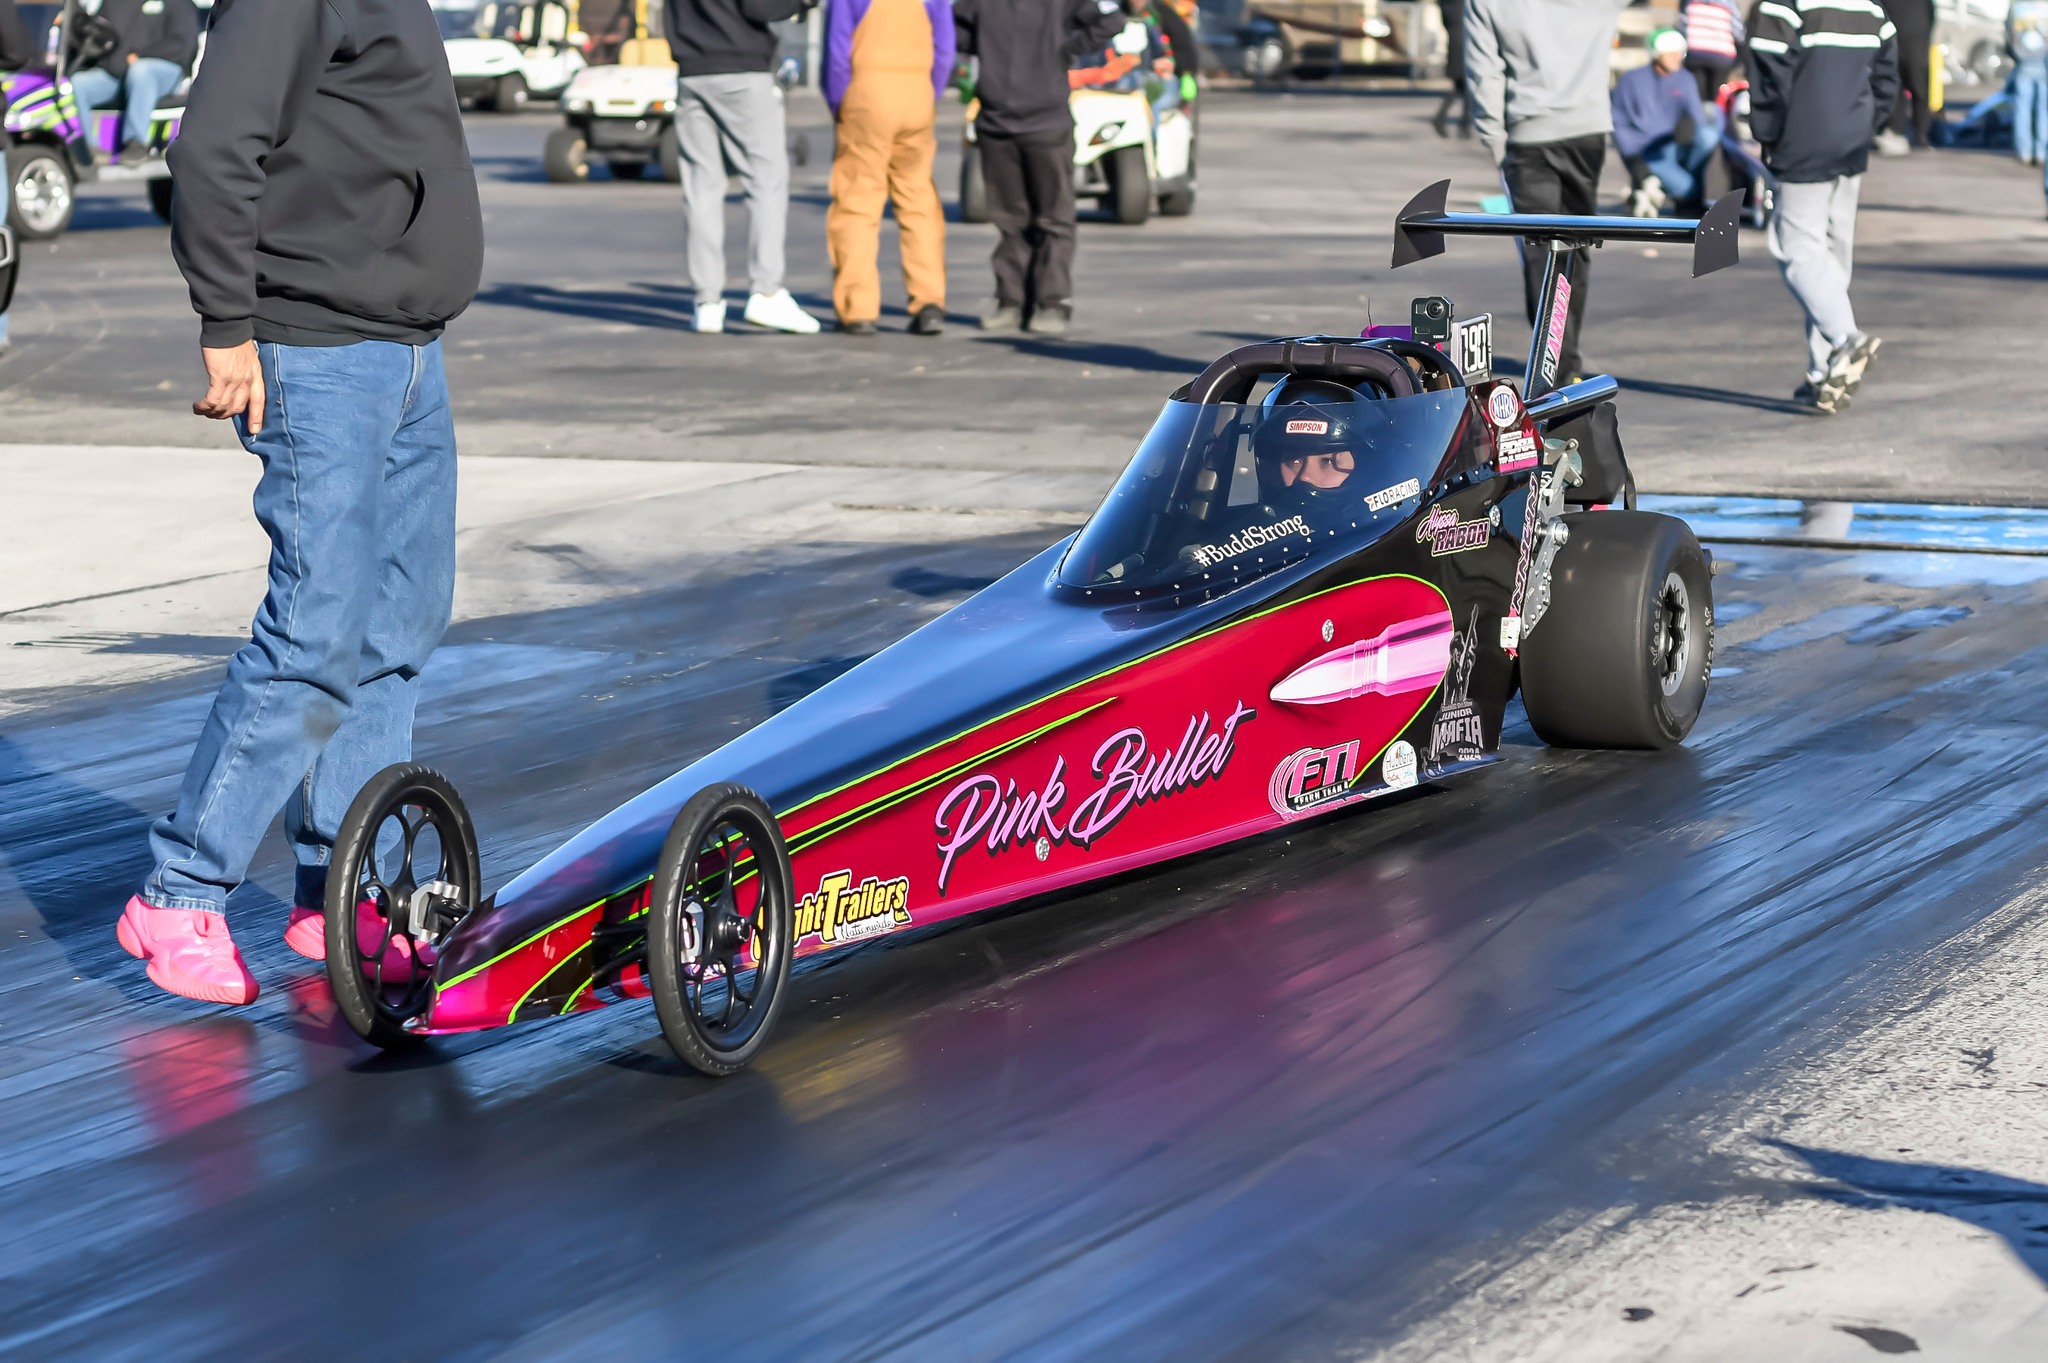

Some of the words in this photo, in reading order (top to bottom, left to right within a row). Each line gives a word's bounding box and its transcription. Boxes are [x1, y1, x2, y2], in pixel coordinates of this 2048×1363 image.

[1493, 393, 1515, 419] NHRA
[1289, 422, 1323, 432] SIMPSON
[1374, 479, 1420, 508] FLORACING
[1417, 505, 1457, 540] Alyssa
[1433, 521, 1489, 553] RABON
[1194, 514, 1310, 567] #BuddStrong
[1439, 707, 1473, 721] JUNIOR
[1430, 715, 1484, 760] MAFIA
[1287, 739, 1360, 798] FTI
[1458, 747, 1481, 761] 2024
[934, 754, 1068, 895] Pink
[1068, 699, 1257, 850] Bullet
[1323, 784, 1343, 798] TEAM
[840, 915, 894, 940] Nationwide
